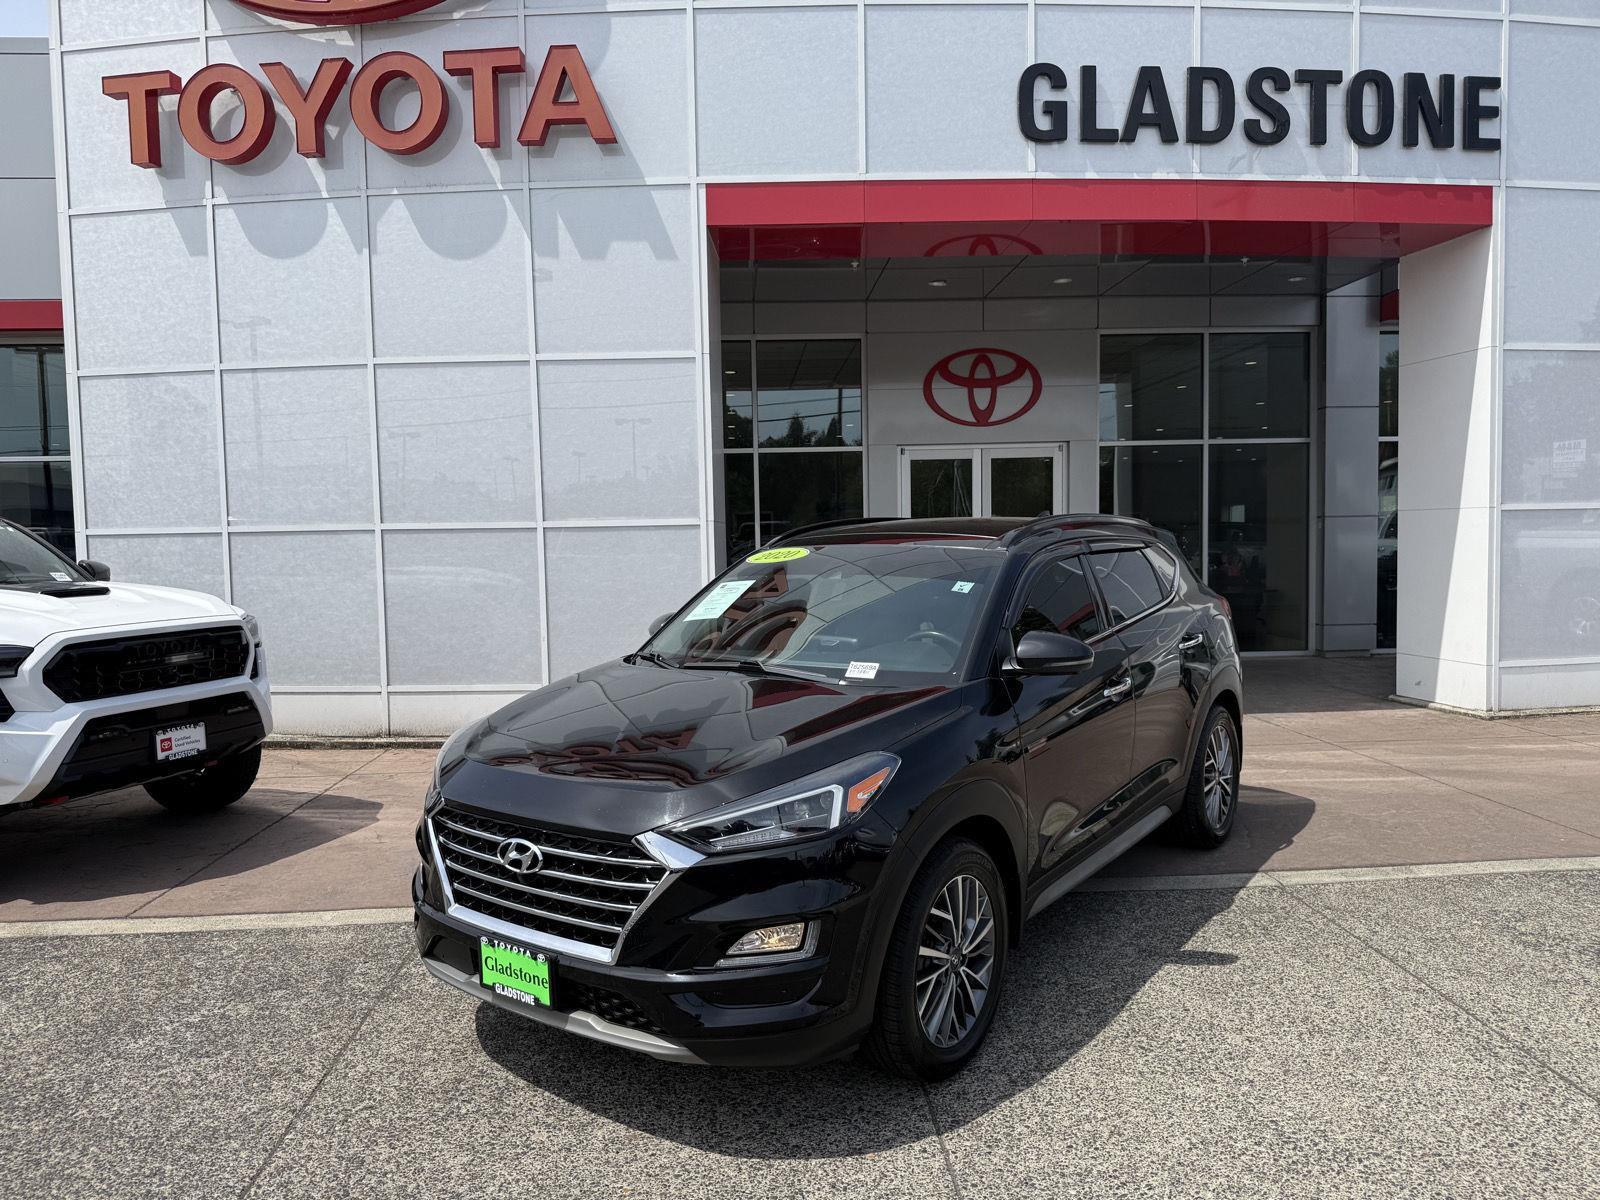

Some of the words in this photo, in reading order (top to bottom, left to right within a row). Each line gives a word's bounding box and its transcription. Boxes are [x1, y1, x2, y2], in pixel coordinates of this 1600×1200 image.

[102, 44, 617, 168] TOYOTA
[1018, 63, 1501, 151] GLADSTONE
[755, 550, 801, 561] 2020
[167, 723, 194, 734] TOYOTA
[168, 748, 198, 760] GLADSTONE
[494, 940, 531, 957] TOYOTA
[484, 955, 548, 989] Gladstone
[495, 983, 535, 1006] GLADSTONE
